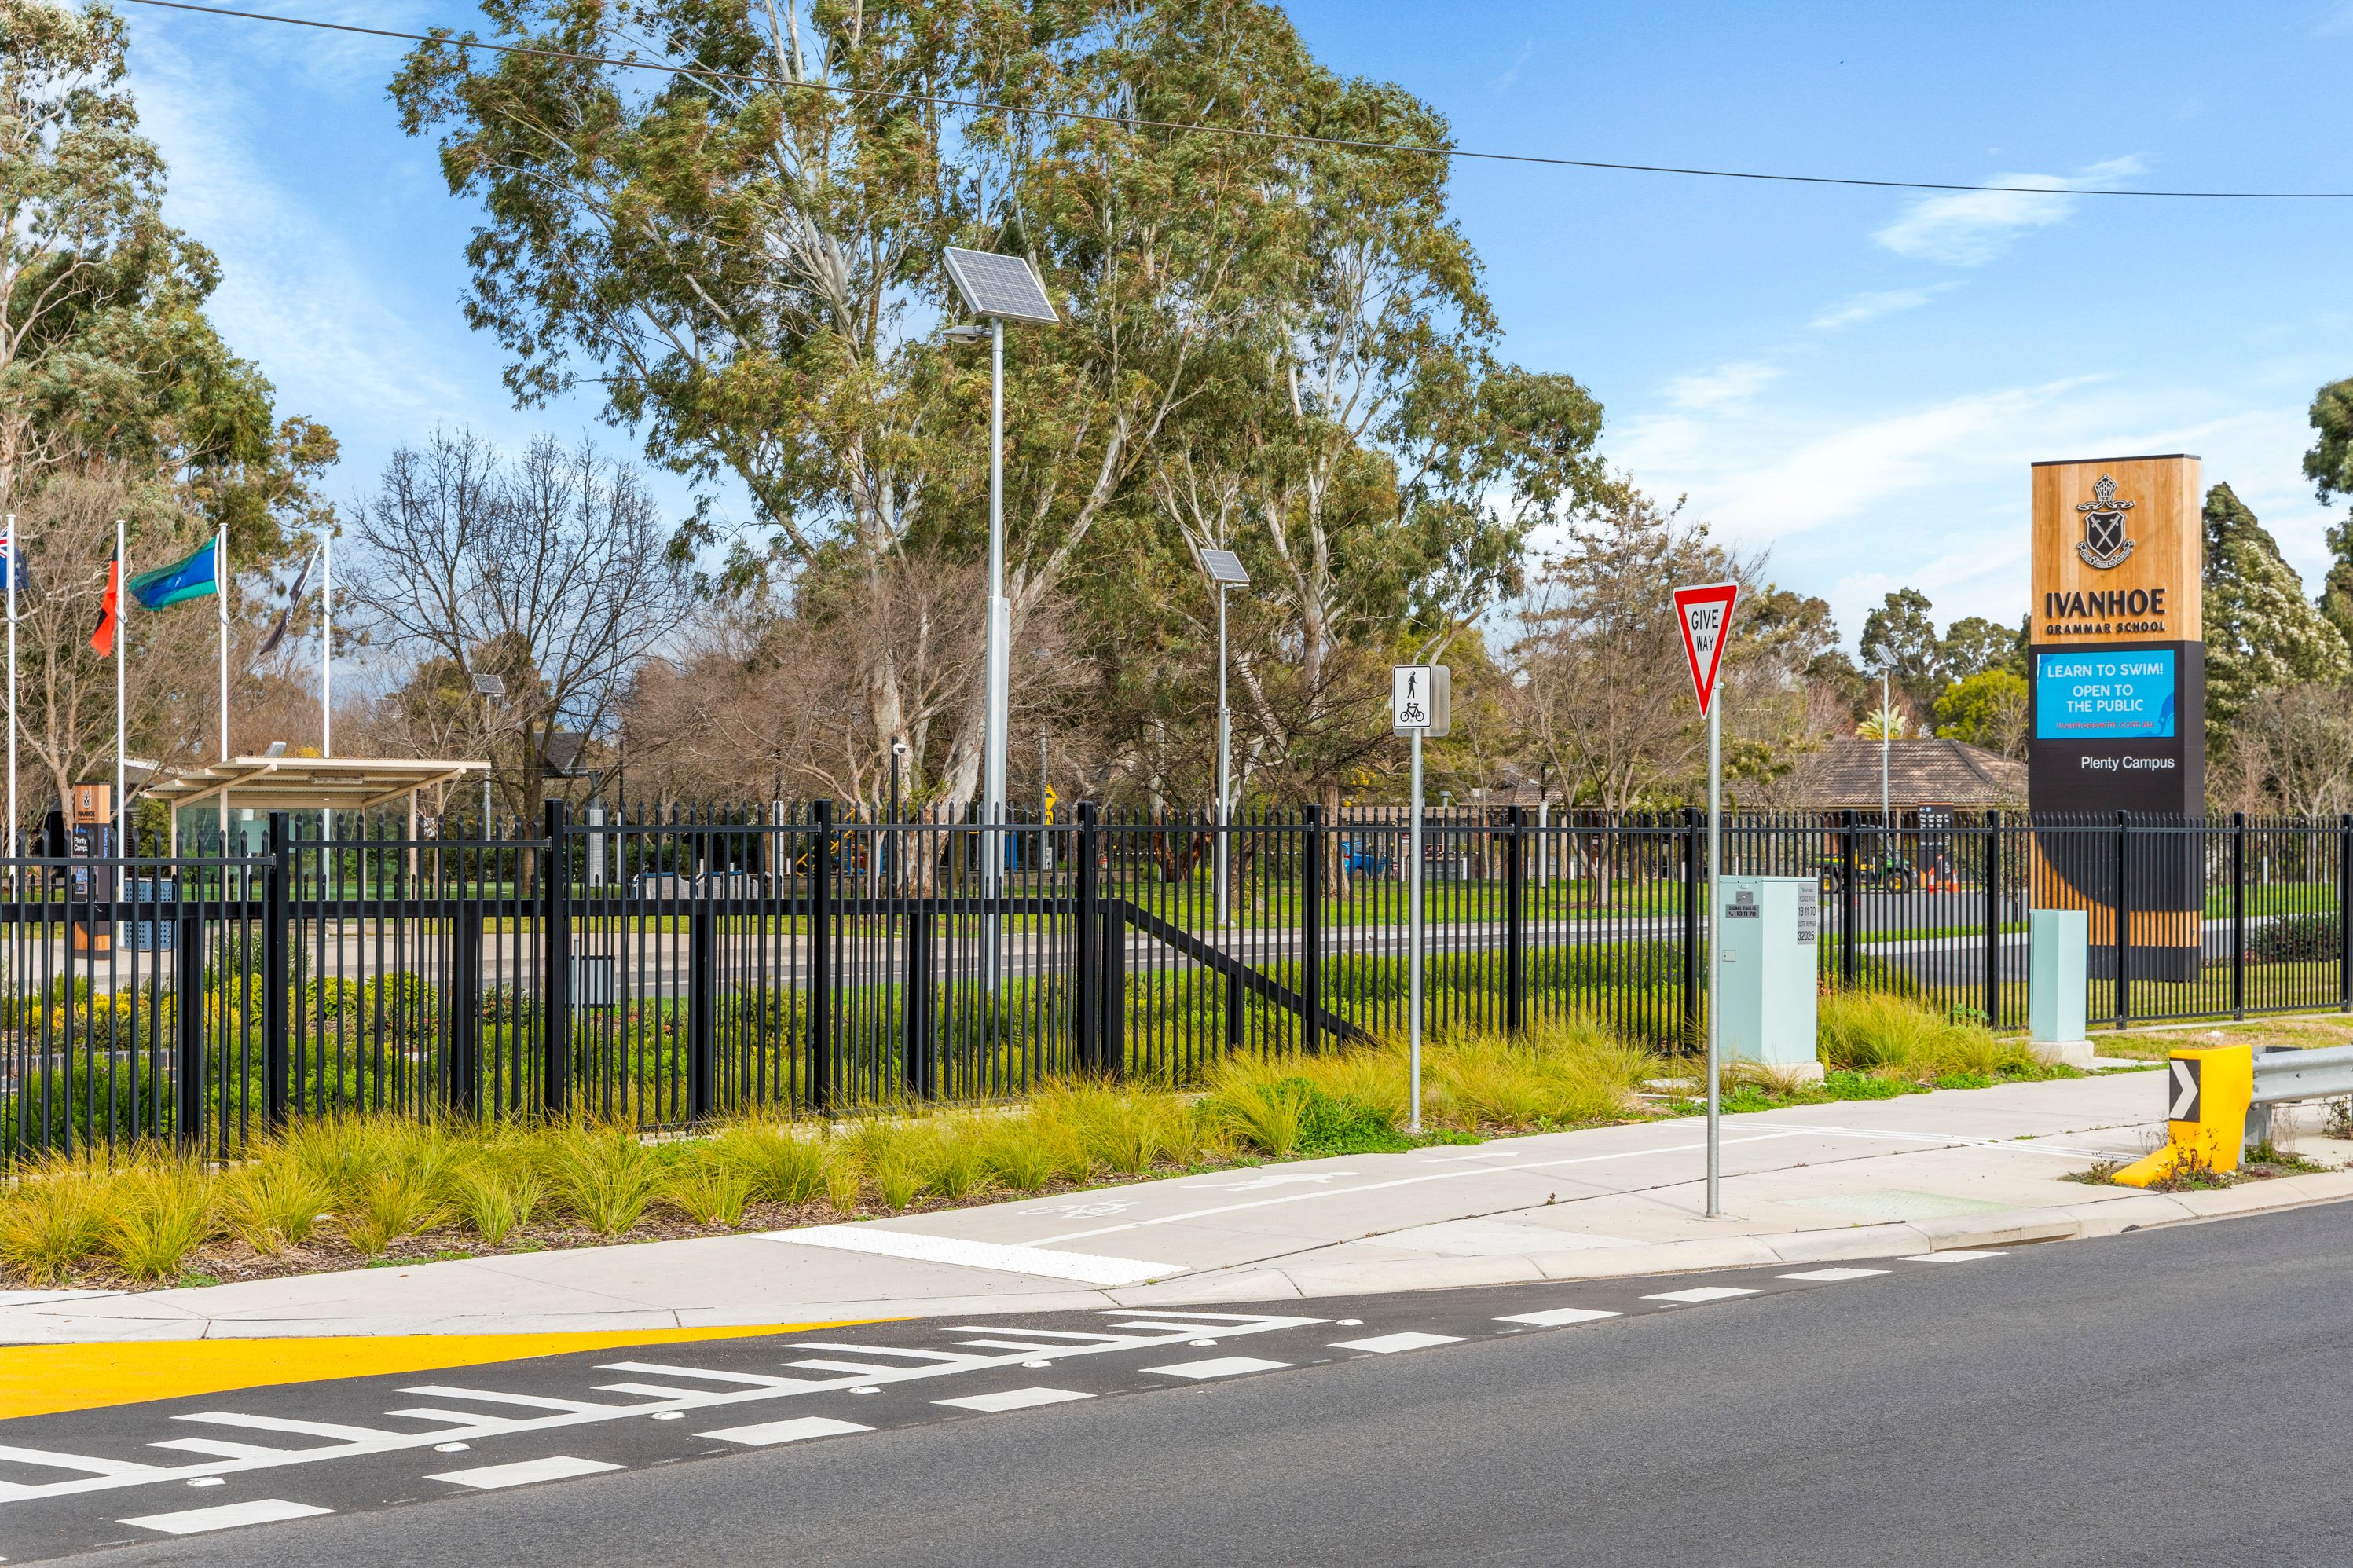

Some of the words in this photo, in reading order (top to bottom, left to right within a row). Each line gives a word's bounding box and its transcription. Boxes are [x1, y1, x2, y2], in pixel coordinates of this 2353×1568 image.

[2046, 588, 2167, 620] IVANHOE
[1691, 609, 1719, 630] GIVE
[2046, 623, 2112, 635] GRAMMAR
[2117, 621, 2167, 633] SCHOOL
[1696, 635, 1715, 652] WAY
[2047, 665, 2092, 678] LEARN
[2096, 664, 2116, 676] TO
[2120, 663, 2164, 676] SWIM!
[2073, 685, 2110, 697] OPEN
[2114, 684, 2134, 696] TO
[2066, 701, 2093, 713] THE
[2097, 699, 2144, 712] PUBLIC
[2057, 721, 2153, 730] ivanhoeswim.com.au
[2081, 757, 2120, 771] Plenty
[2122, 756, 2175, 771] Campus
[1798, 907, 1804, 916] 13
[1809, 907, 1816, 916] 70
[1798, 931, 1815, 941] 32025
